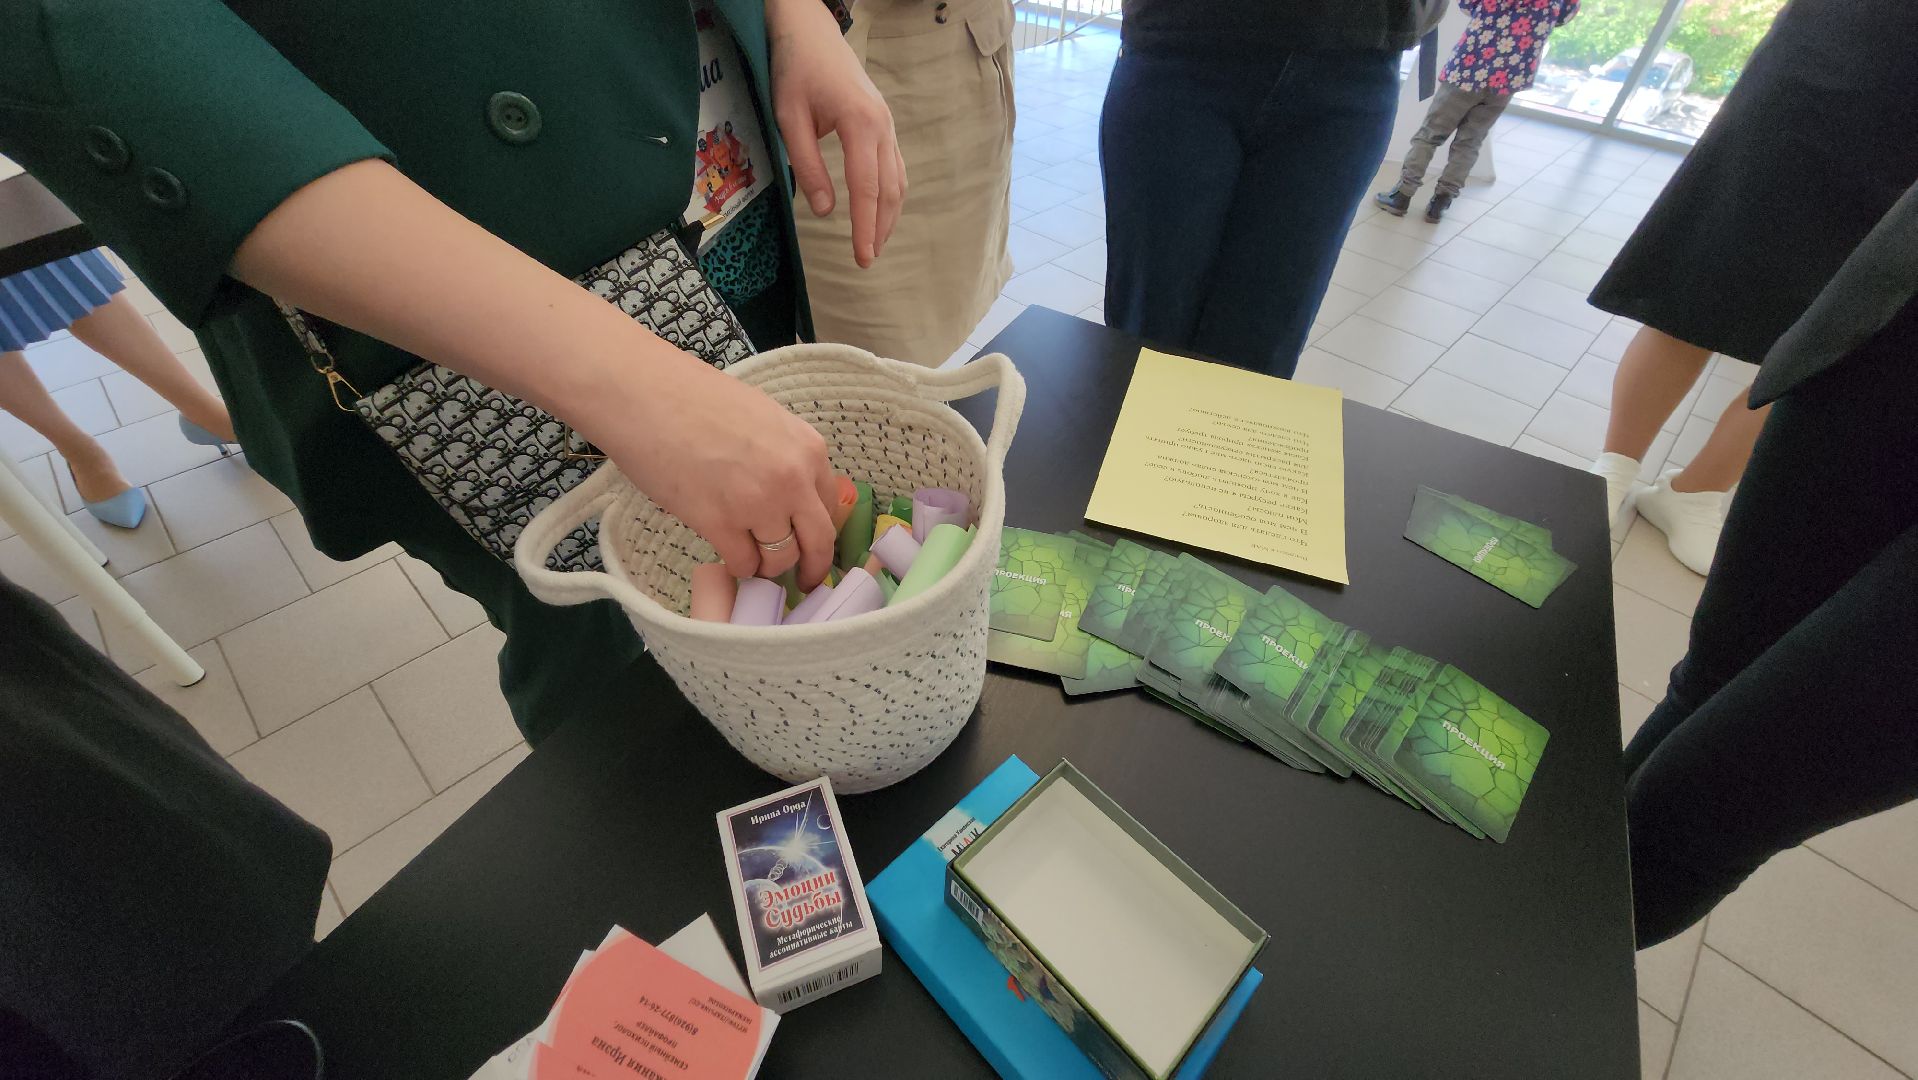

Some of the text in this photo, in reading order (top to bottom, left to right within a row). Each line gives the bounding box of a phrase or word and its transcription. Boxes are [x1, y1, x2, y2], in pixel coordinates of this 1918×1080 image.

[1194, 618, 1232, 643] ПРОЕК
[1441, 719, 1506, 770] ПРОЕКЦИЯ
[750, 801, 807, 825] Ирина Орда
[760, 871, 836, 908] Эмоции
[765, 891, 842, 928] Судьбы
[769, 921, 853, 959] ассоциативные карты
[776, 916, 842, 946] Метафорические
[591, 1036, 627, 1066] Ирэна
